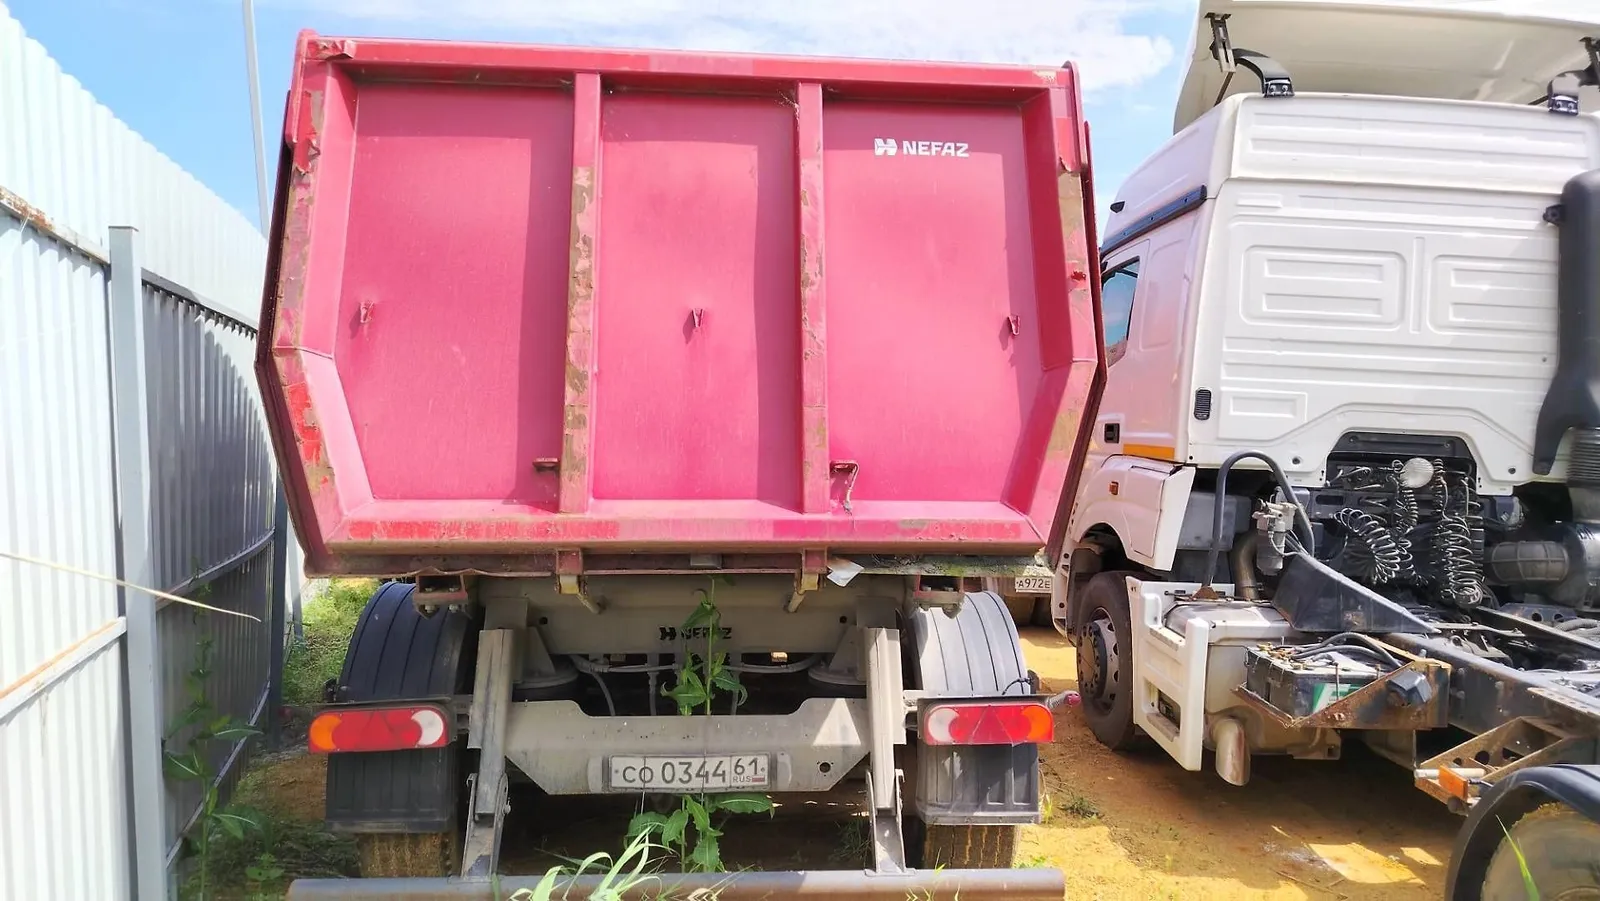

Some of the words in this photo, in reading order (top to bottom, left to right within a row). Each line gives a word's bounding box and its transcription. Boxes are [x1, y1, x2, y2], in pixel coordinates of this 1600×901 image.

[902, 140, 969, 157] NEFAZ
[681, 627, 732, 640] NEFZ
[661, 760, 726, 784] 0344
[733, 757, 759, 775] 61
[732, 775, 751, 783] RUS
